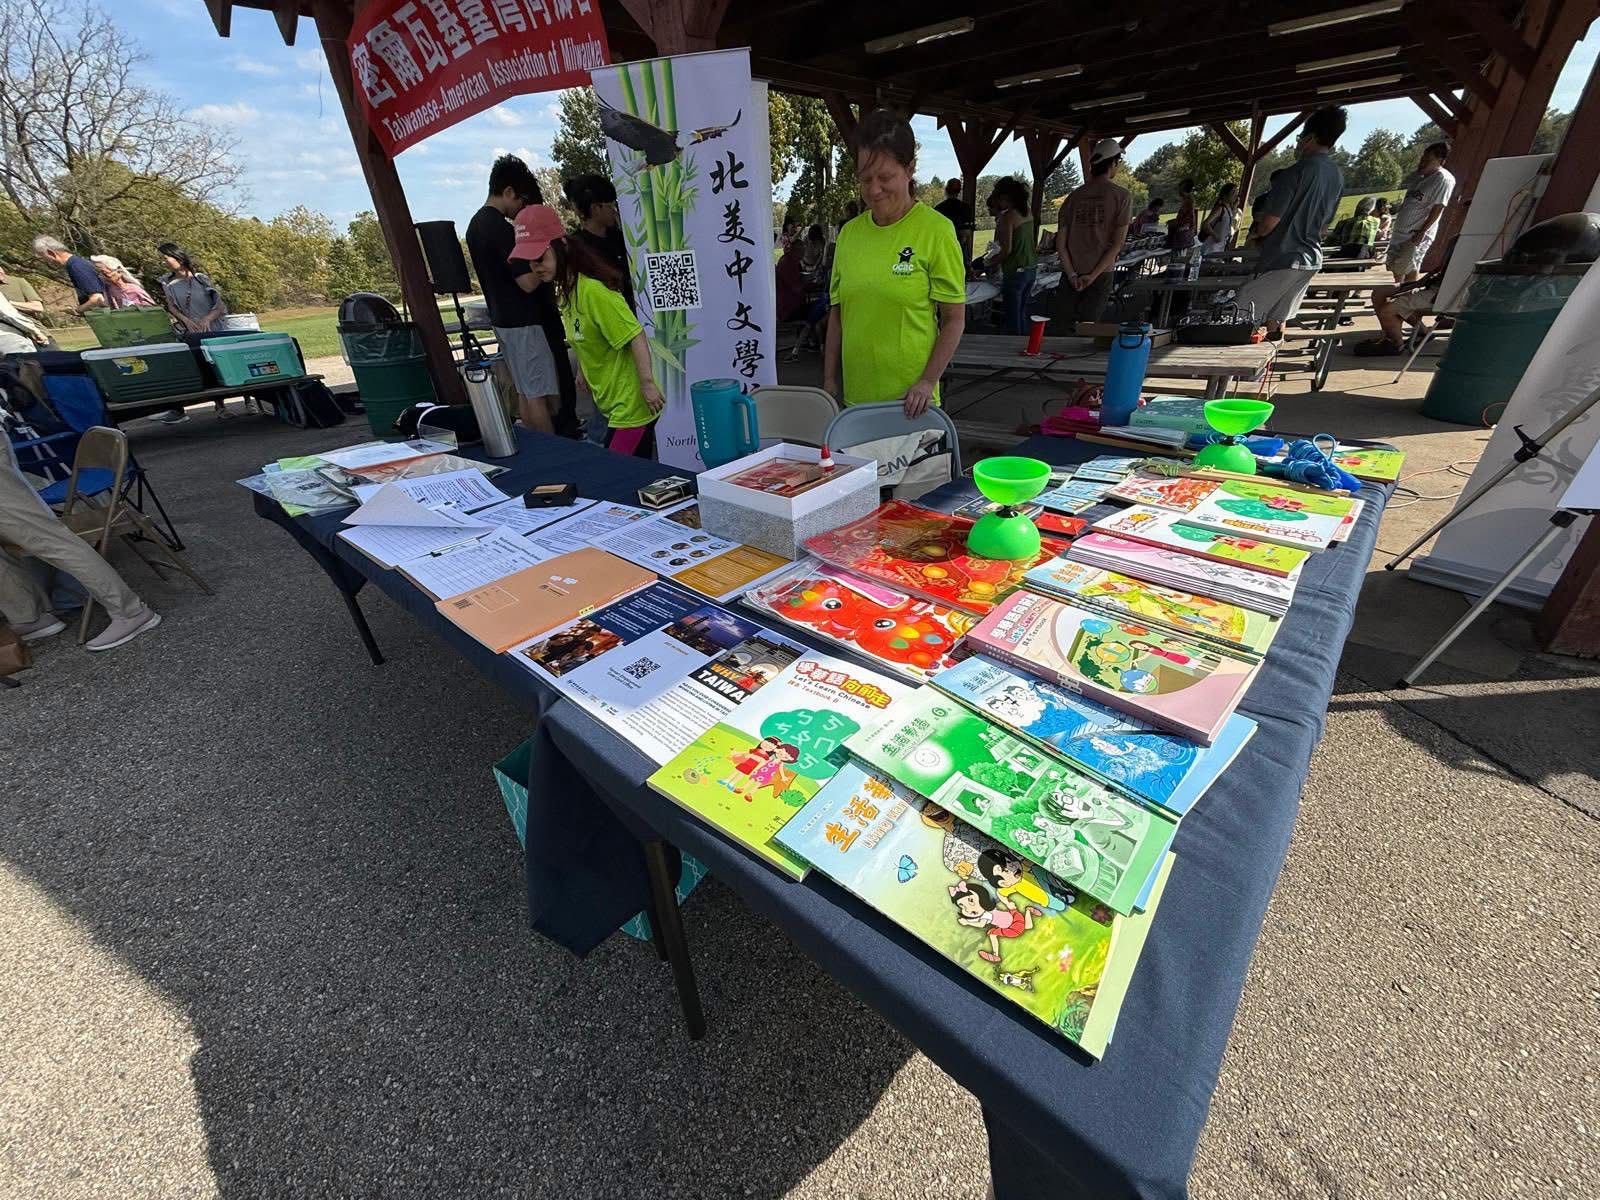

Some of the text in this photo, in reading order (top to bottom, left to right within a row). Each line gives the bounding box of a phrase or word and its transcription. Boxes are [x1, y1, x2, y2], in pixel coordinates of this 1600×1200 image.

[382, 71, 489, 142] Taiwanese-American
[487, 46, 548, 88] Association
[548, 40, 560, 75] of
[710, 150, 764, 397] 北美中文學
[666, 435, 697, 447] North
[698, 669, 746, 702] TAIWA
[711, 663, 738, 680] WHY
[794, 674, 871, 709] Let's Learn Chinese
[802, 686, 831, 700] Textbook
